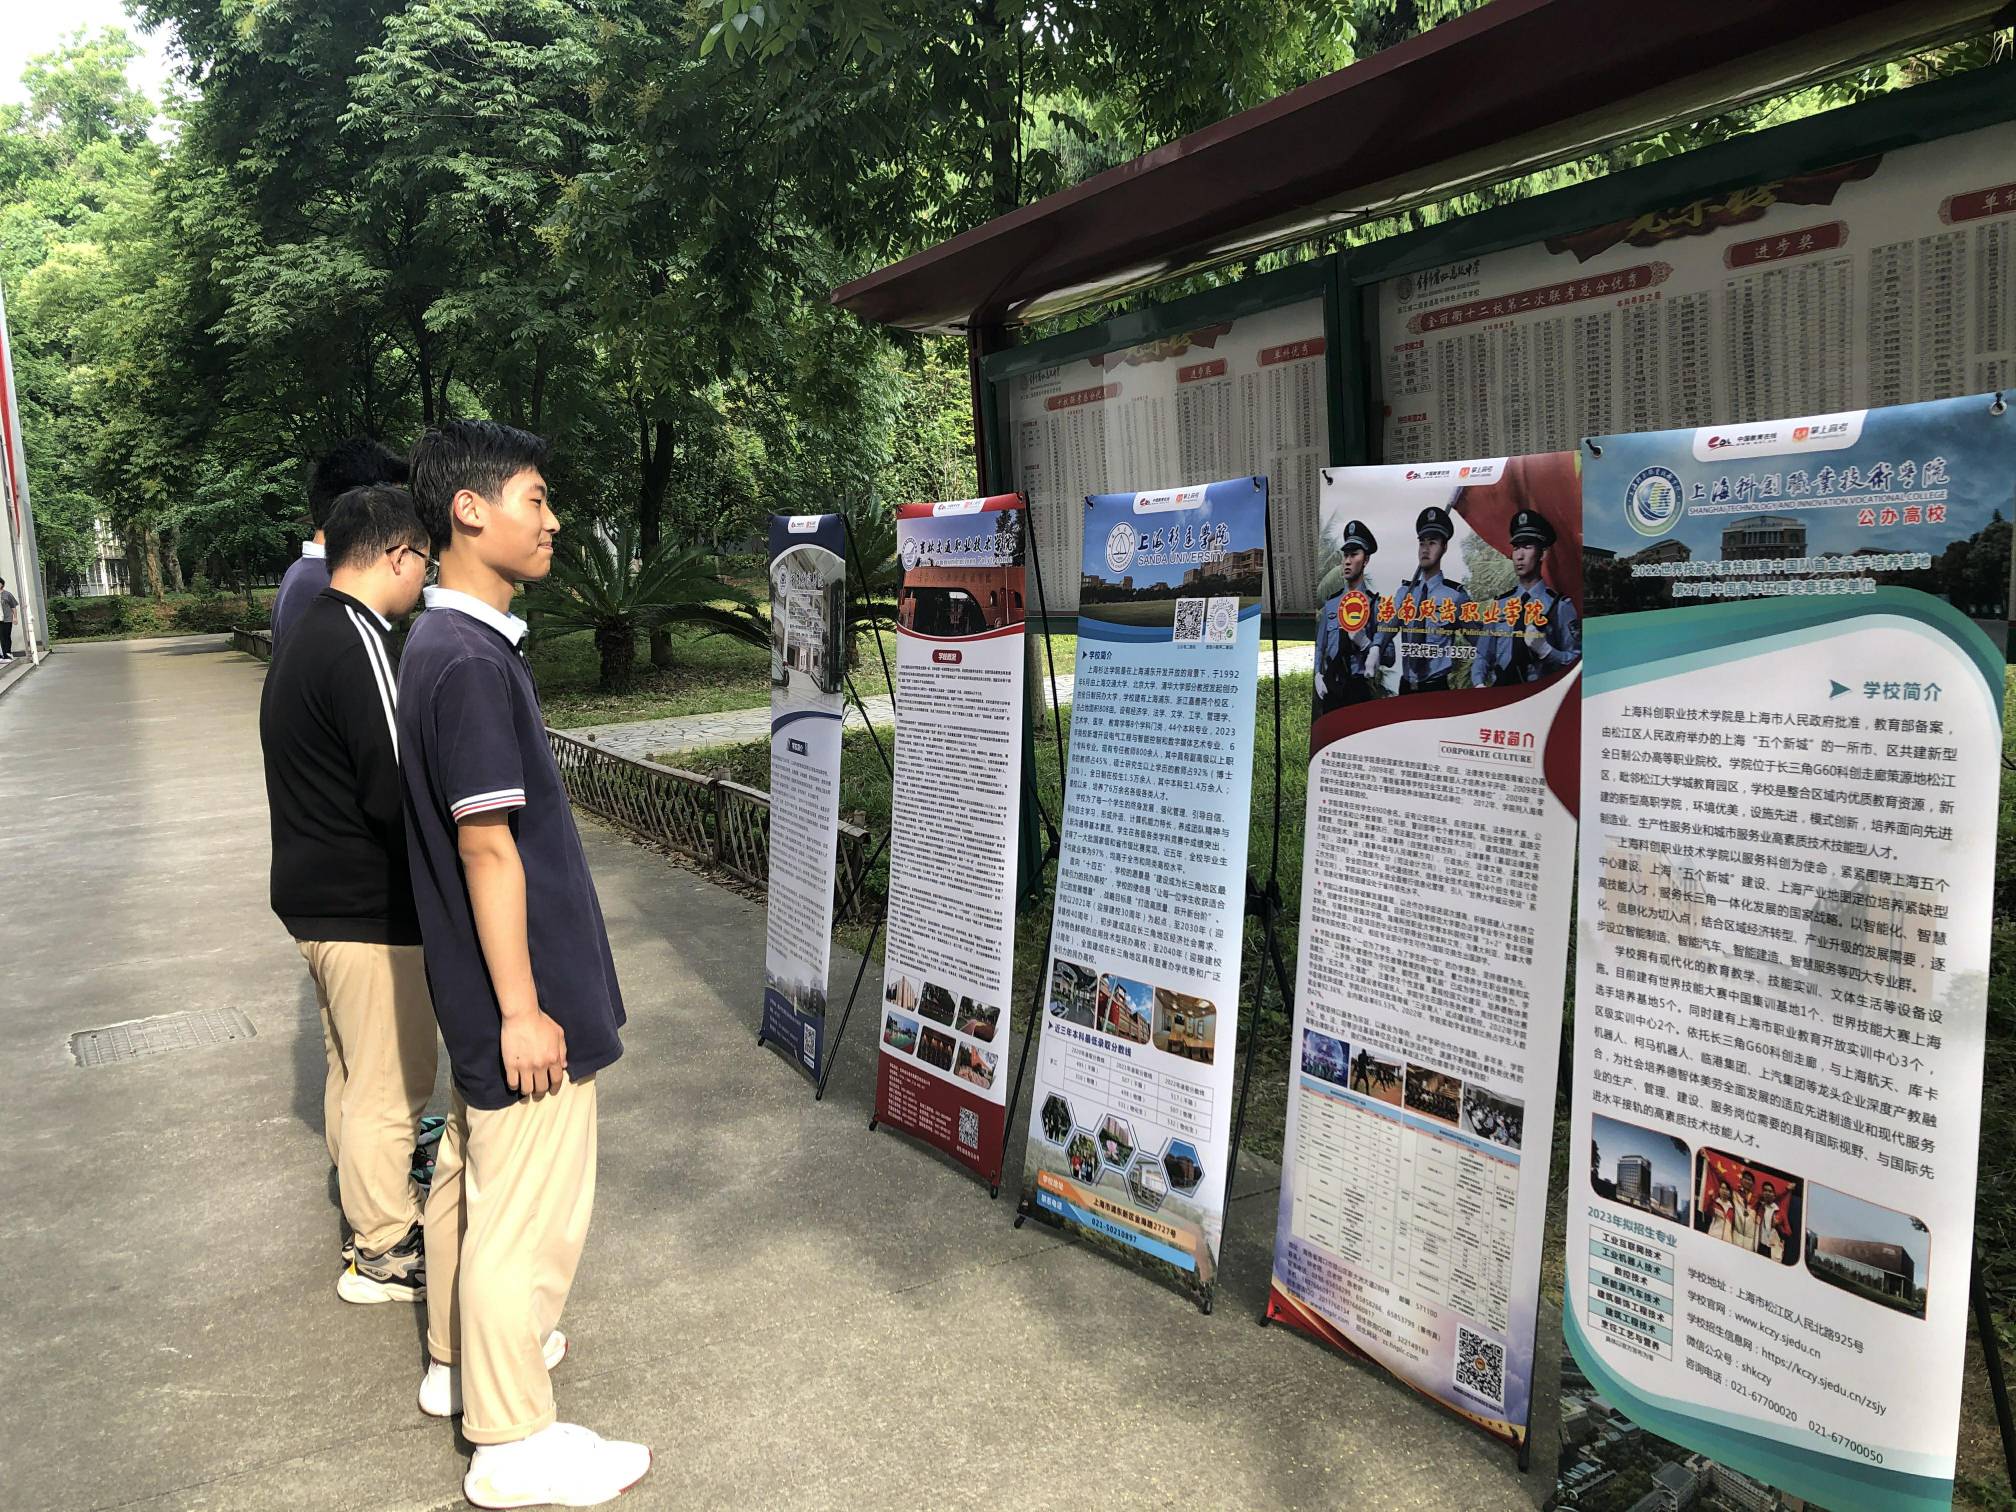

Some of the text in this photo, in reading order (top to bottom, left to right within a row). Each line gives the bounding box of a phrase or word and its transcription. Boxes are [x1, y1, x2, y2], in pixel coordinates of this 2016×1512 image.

[1753, 232, 1813, 260] 进步奖
[1811, 422, 1849, 434] 掌上高考
[1689, 490, 1948, 515] SHANGHAI TECHNOLOGY AND INNOVATION VOCATIONAL COLLEGE
[1858, 504, 1947, 527] 公办高校
[1138, 550, 1226, 566] SANDA UNIVERSITY
[1631, 553, 1931, 578] 2022世界技能大赛特别赛中国队首金选手培养基地
[1672, 578, 1877, 598] 第27届中国青年五四奖章获奖单位
[1376, 593, 1548, 626] 海南政法职业学院
[1089, 651, 1113, 661] 学校简介
[1864, 681, 1943, 701] 学校简介
[1441, 746, 1533, 764] CORPORATE CULTURE
[1588, 1206, 1678, 1248] 2023年拟招生专业
[1602, 1233, 1662, 1261] 工业互联网技术
[1602, 1247, 1662, 1276] 工业机器人技术
[1808, 1420, 1884, 1464] 021-67700050
